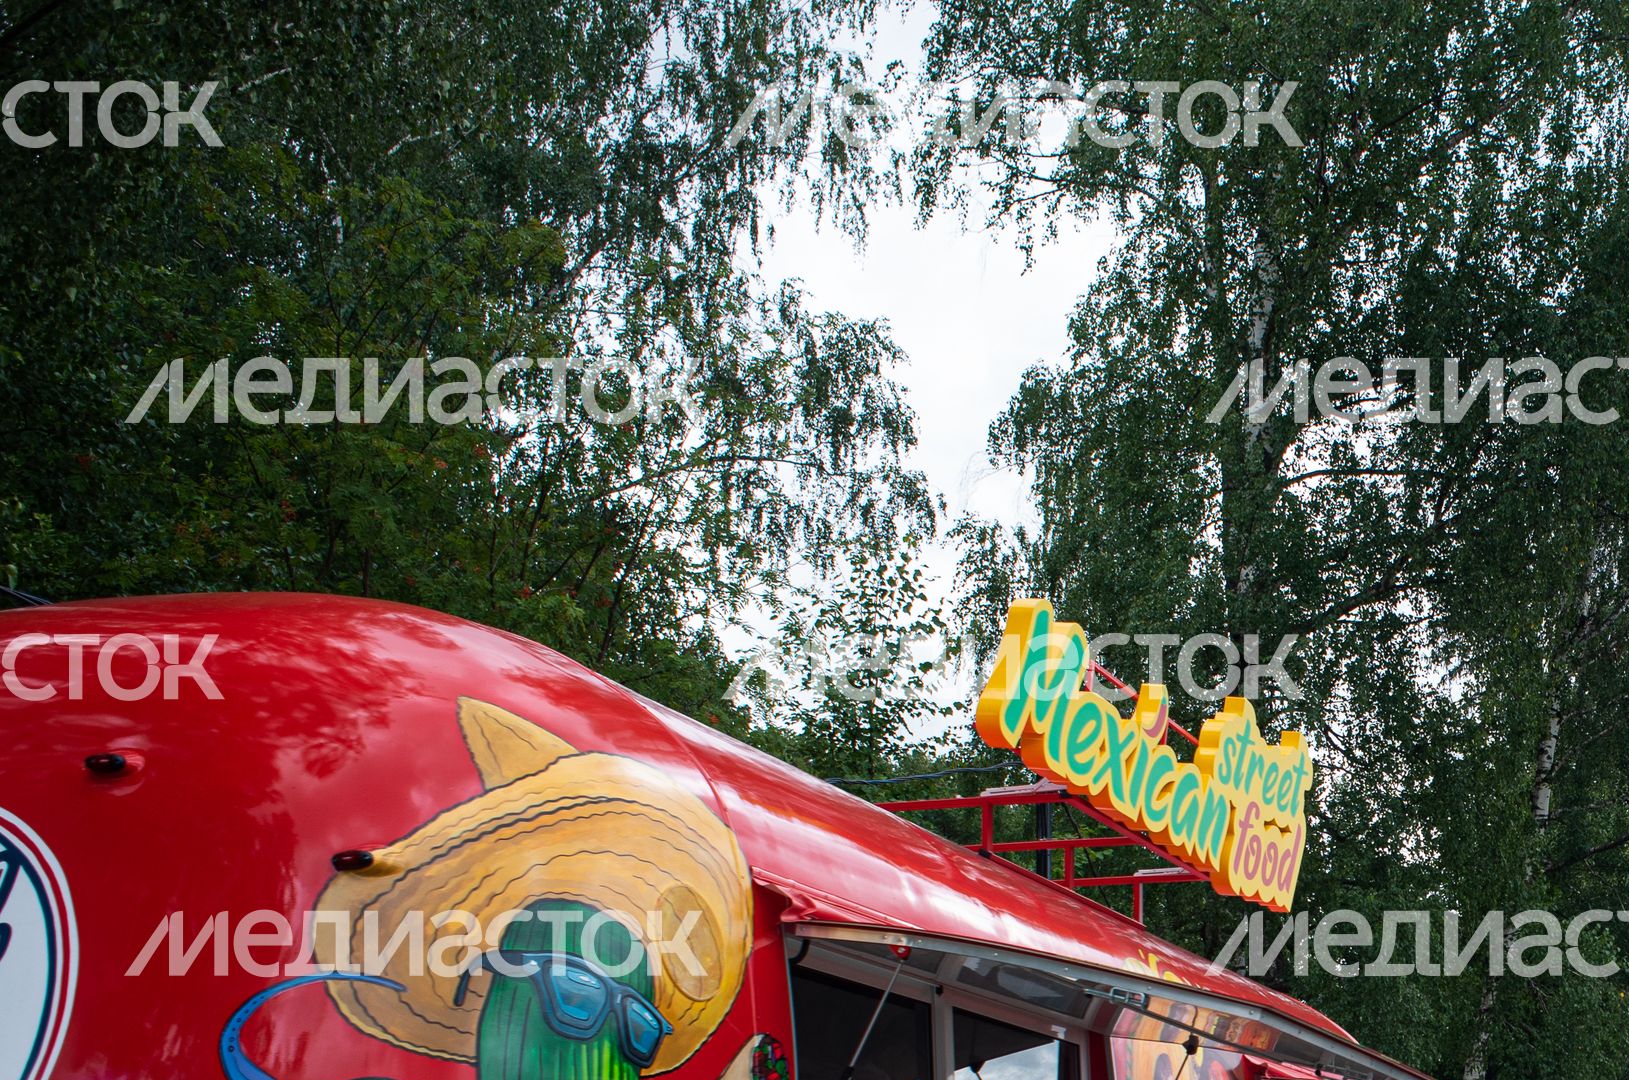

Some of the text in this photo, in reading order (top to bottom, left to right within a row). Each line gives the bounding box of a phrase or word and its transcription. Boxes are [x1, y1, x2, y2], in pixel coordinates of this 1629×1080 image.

[1004, 609, 1227, 859] Mexican
[1218, 720, 1309, 817] street
[1233, 801, 1302, 894] food
